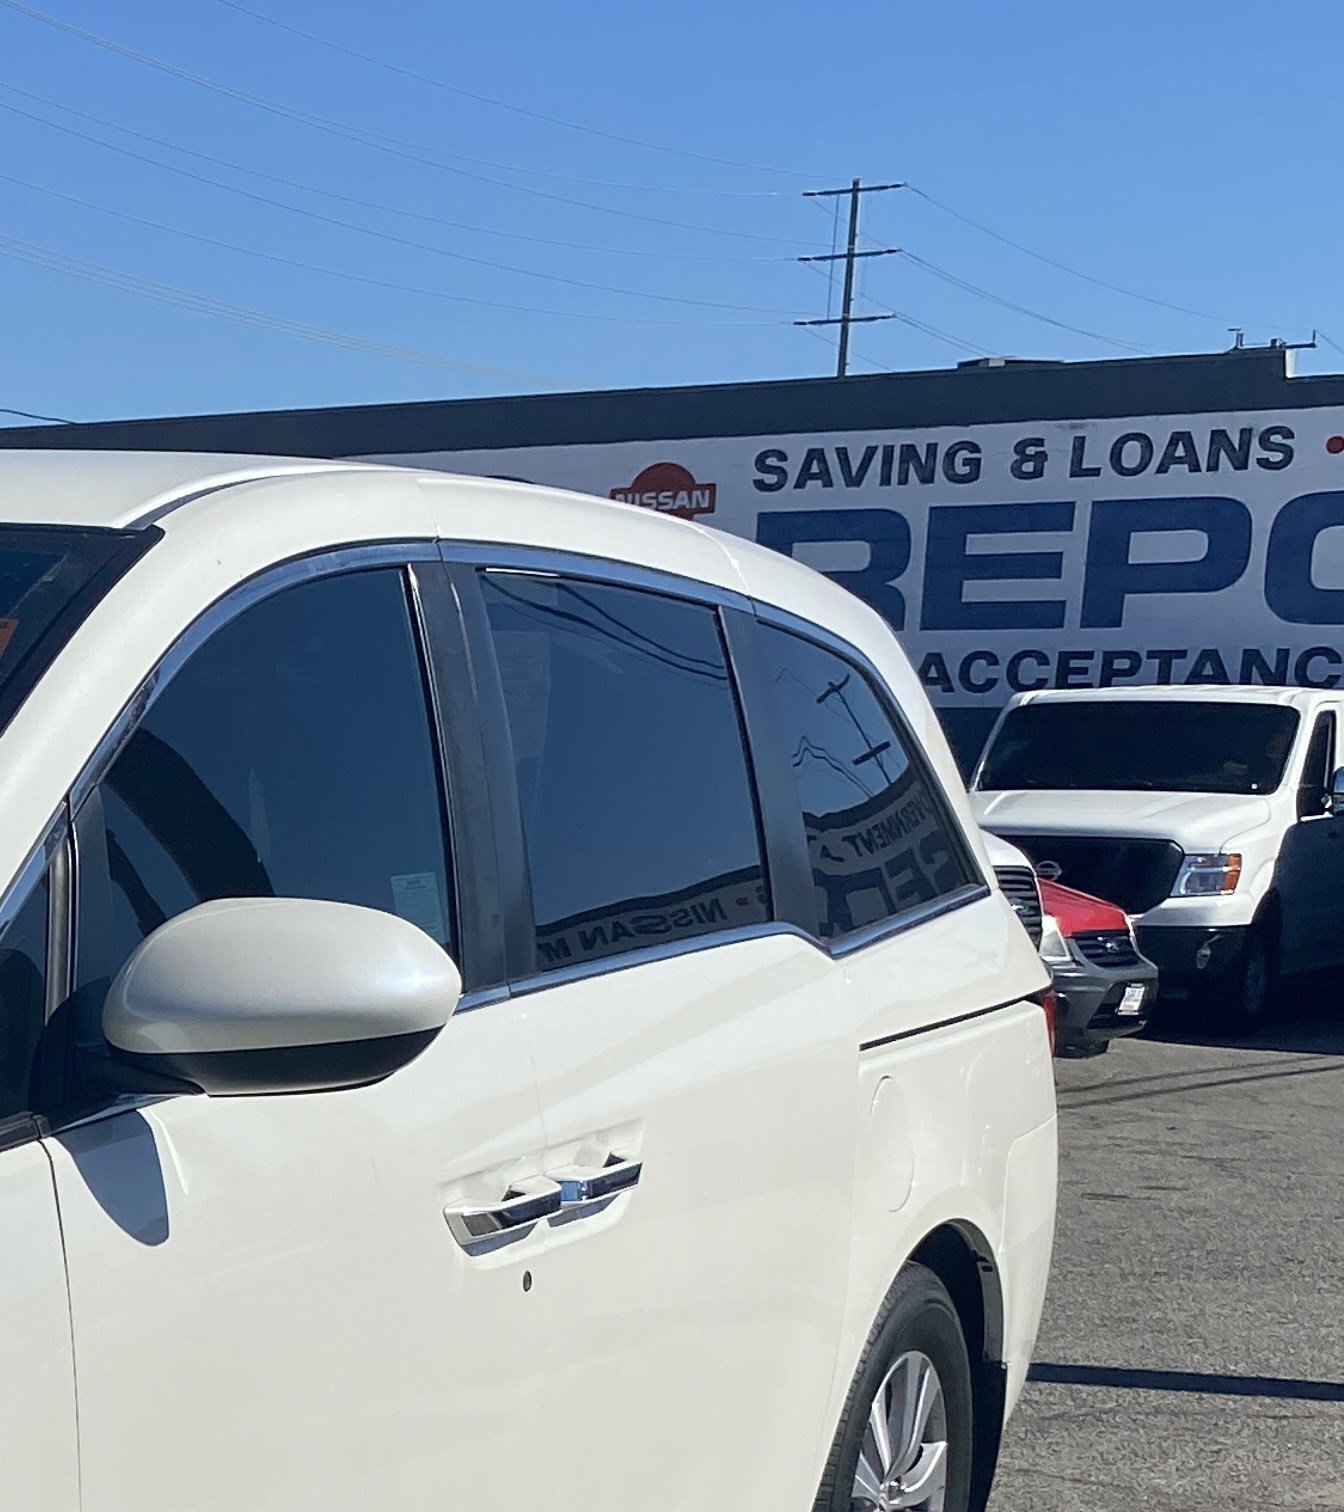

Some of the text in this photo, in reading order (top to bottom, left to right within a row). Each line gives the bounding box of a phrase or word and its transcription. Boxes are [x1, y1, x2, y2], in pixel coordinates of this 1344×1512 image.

[752, 426, 1296, 493] SAVING & LOANS
